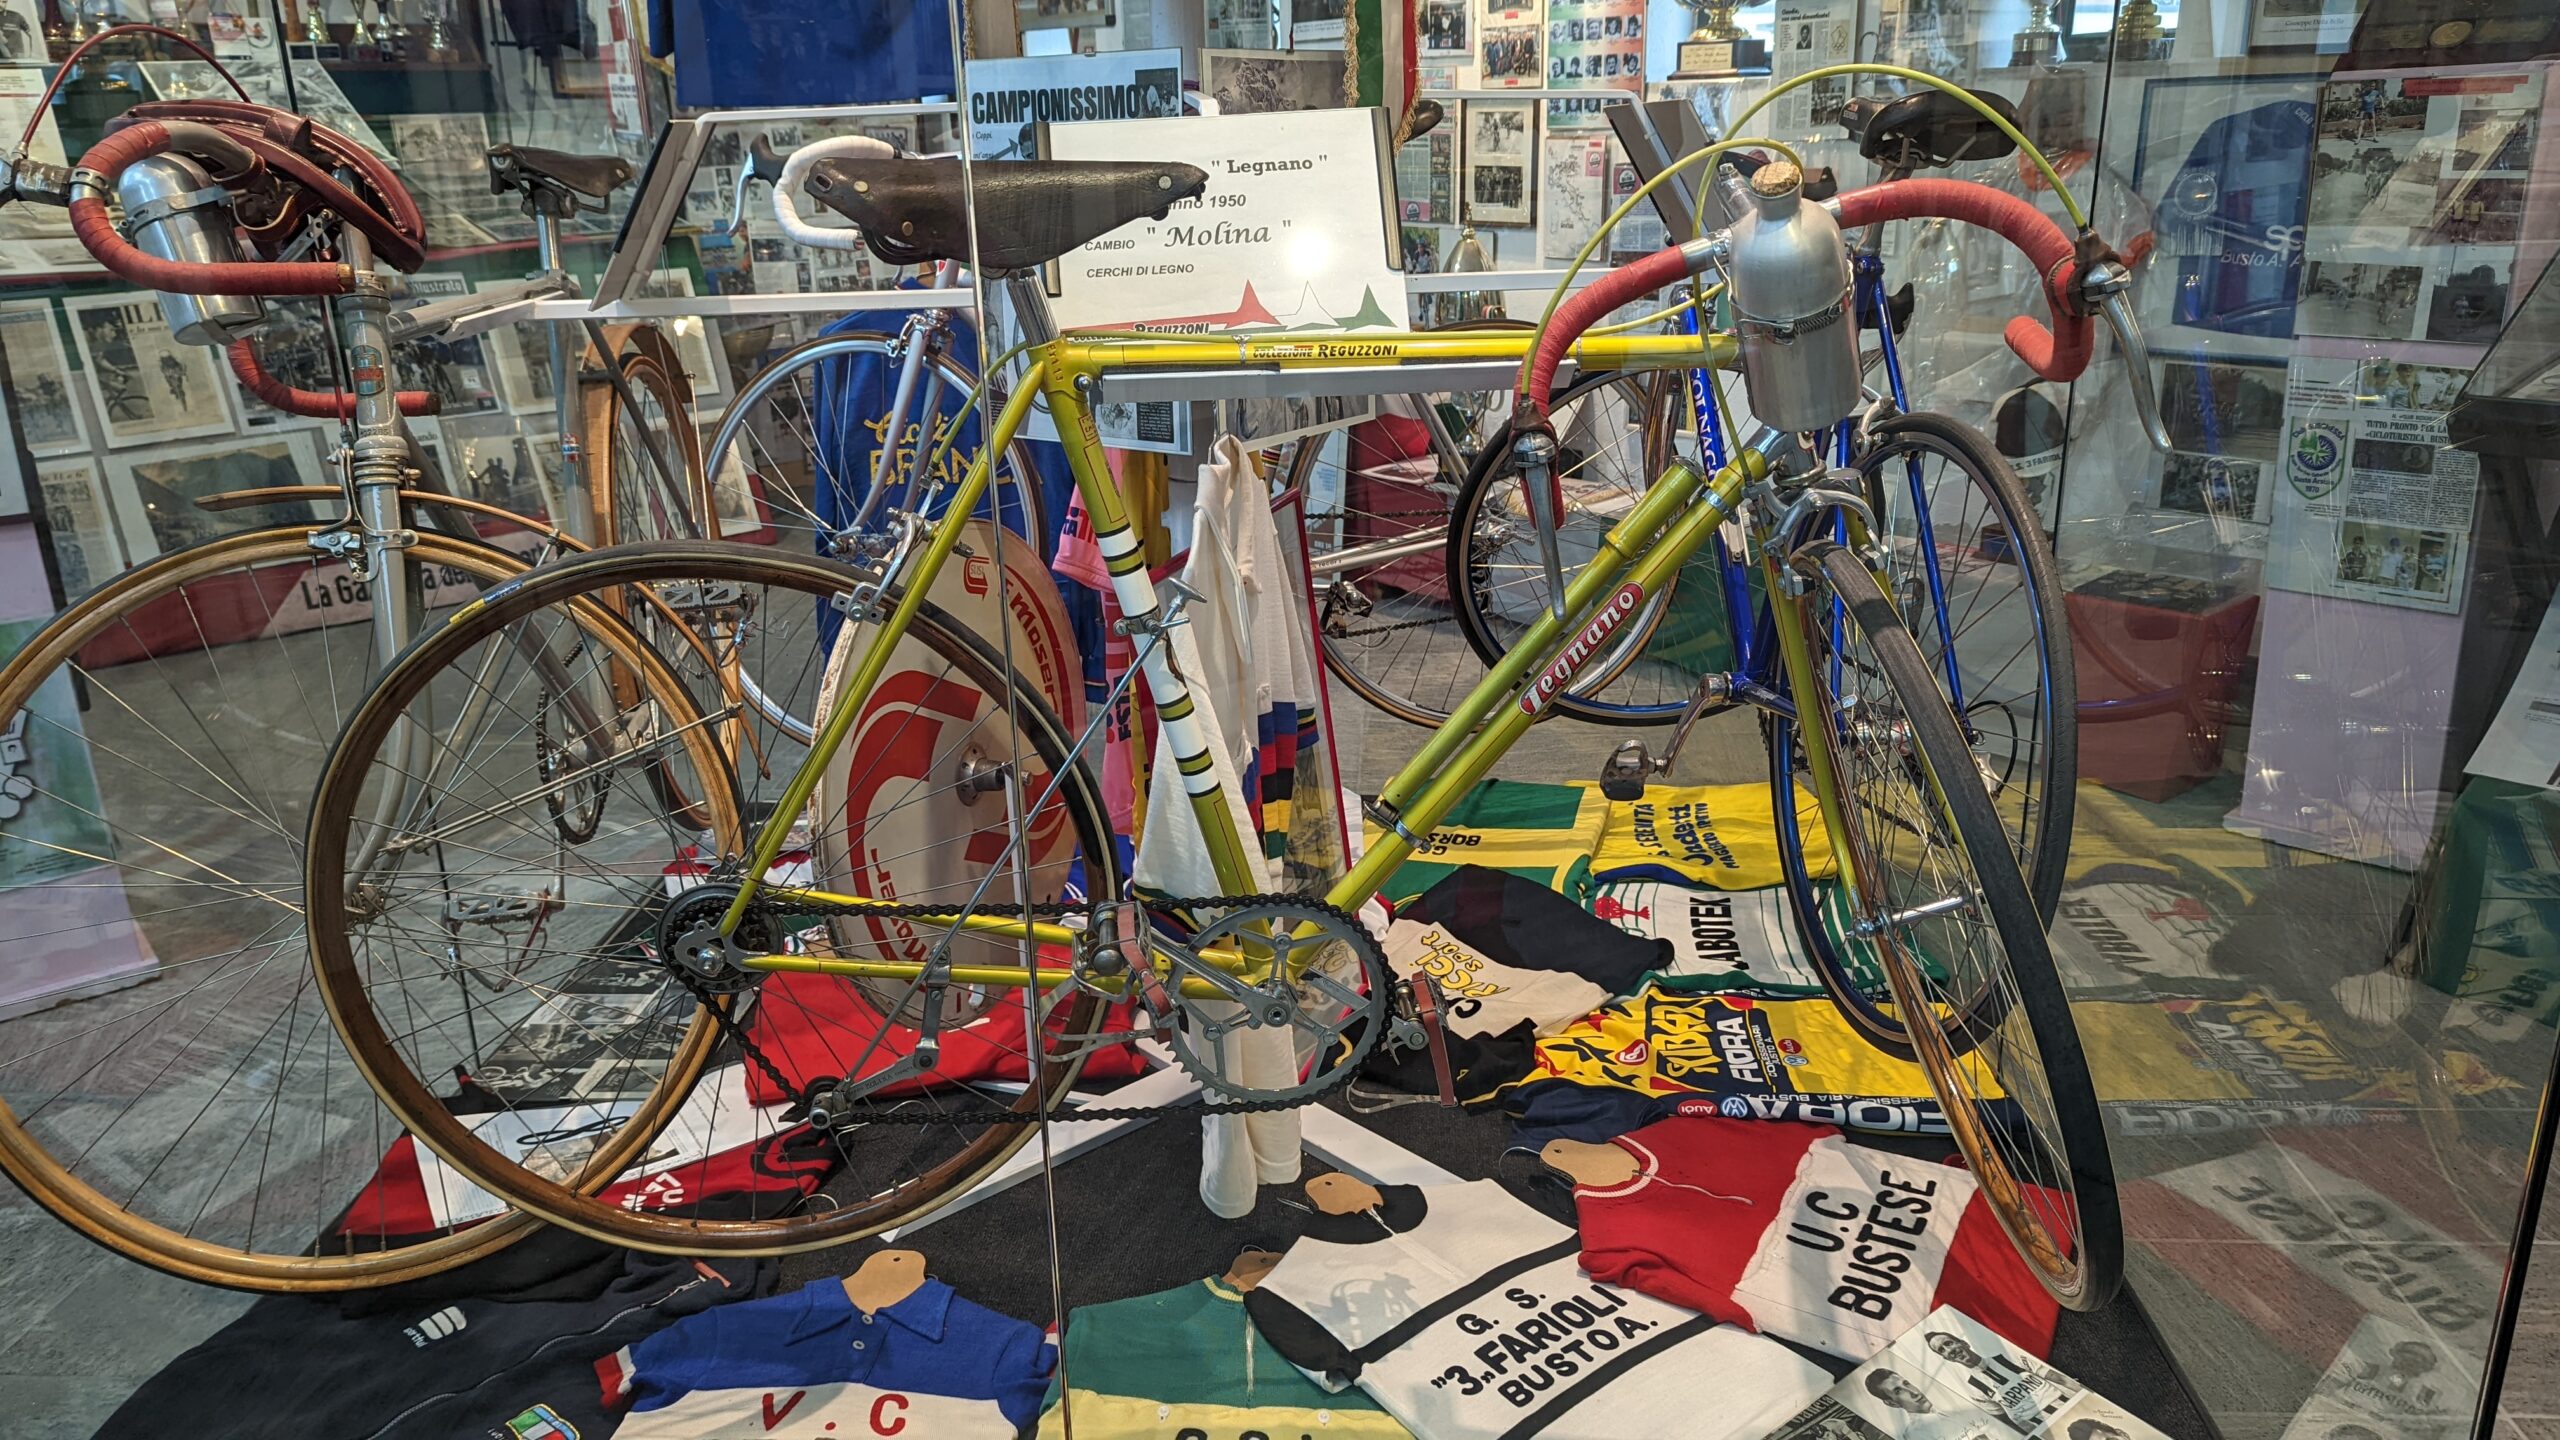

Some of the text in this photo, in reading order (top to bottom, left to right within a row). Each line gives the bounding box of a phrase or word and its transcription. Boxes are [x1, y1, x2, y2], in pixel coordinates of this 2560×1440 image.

[972, 84, 1140, 124] CAMPIONISSIMO
[1227, 159, 1313, 176] Legnano
[1168, 194, 1247, 211] nno 1950
[1084, 220, 1272, 252] CAMBIO Molina
[1086, 263, 1195, 279] CERCHI DI LEGNO
[1318, 344, 1398, 358] REGUZZONI
[2366, 419, 2389, 430] TUTTO
[2390, 422, 2417, 433] PRONTO
[1716, 1016, 1764, 1083] FIORA
[1751, 1024, 1778, 1078] COESSIONARIA
[1681, 1104, 1714, 1116] Audi
[1745, 1096, 1952, 1134] FIORA
[1827, 1170, 1938, 1322] BUSTESE
[1455, 1287, 1547, 1336] G. S.
[1474, 1284, 1628, 1376] FARIOLI
[1998, 1373, 2045, 1411] CARPANO
[869, 1393, 909, 1437] C
